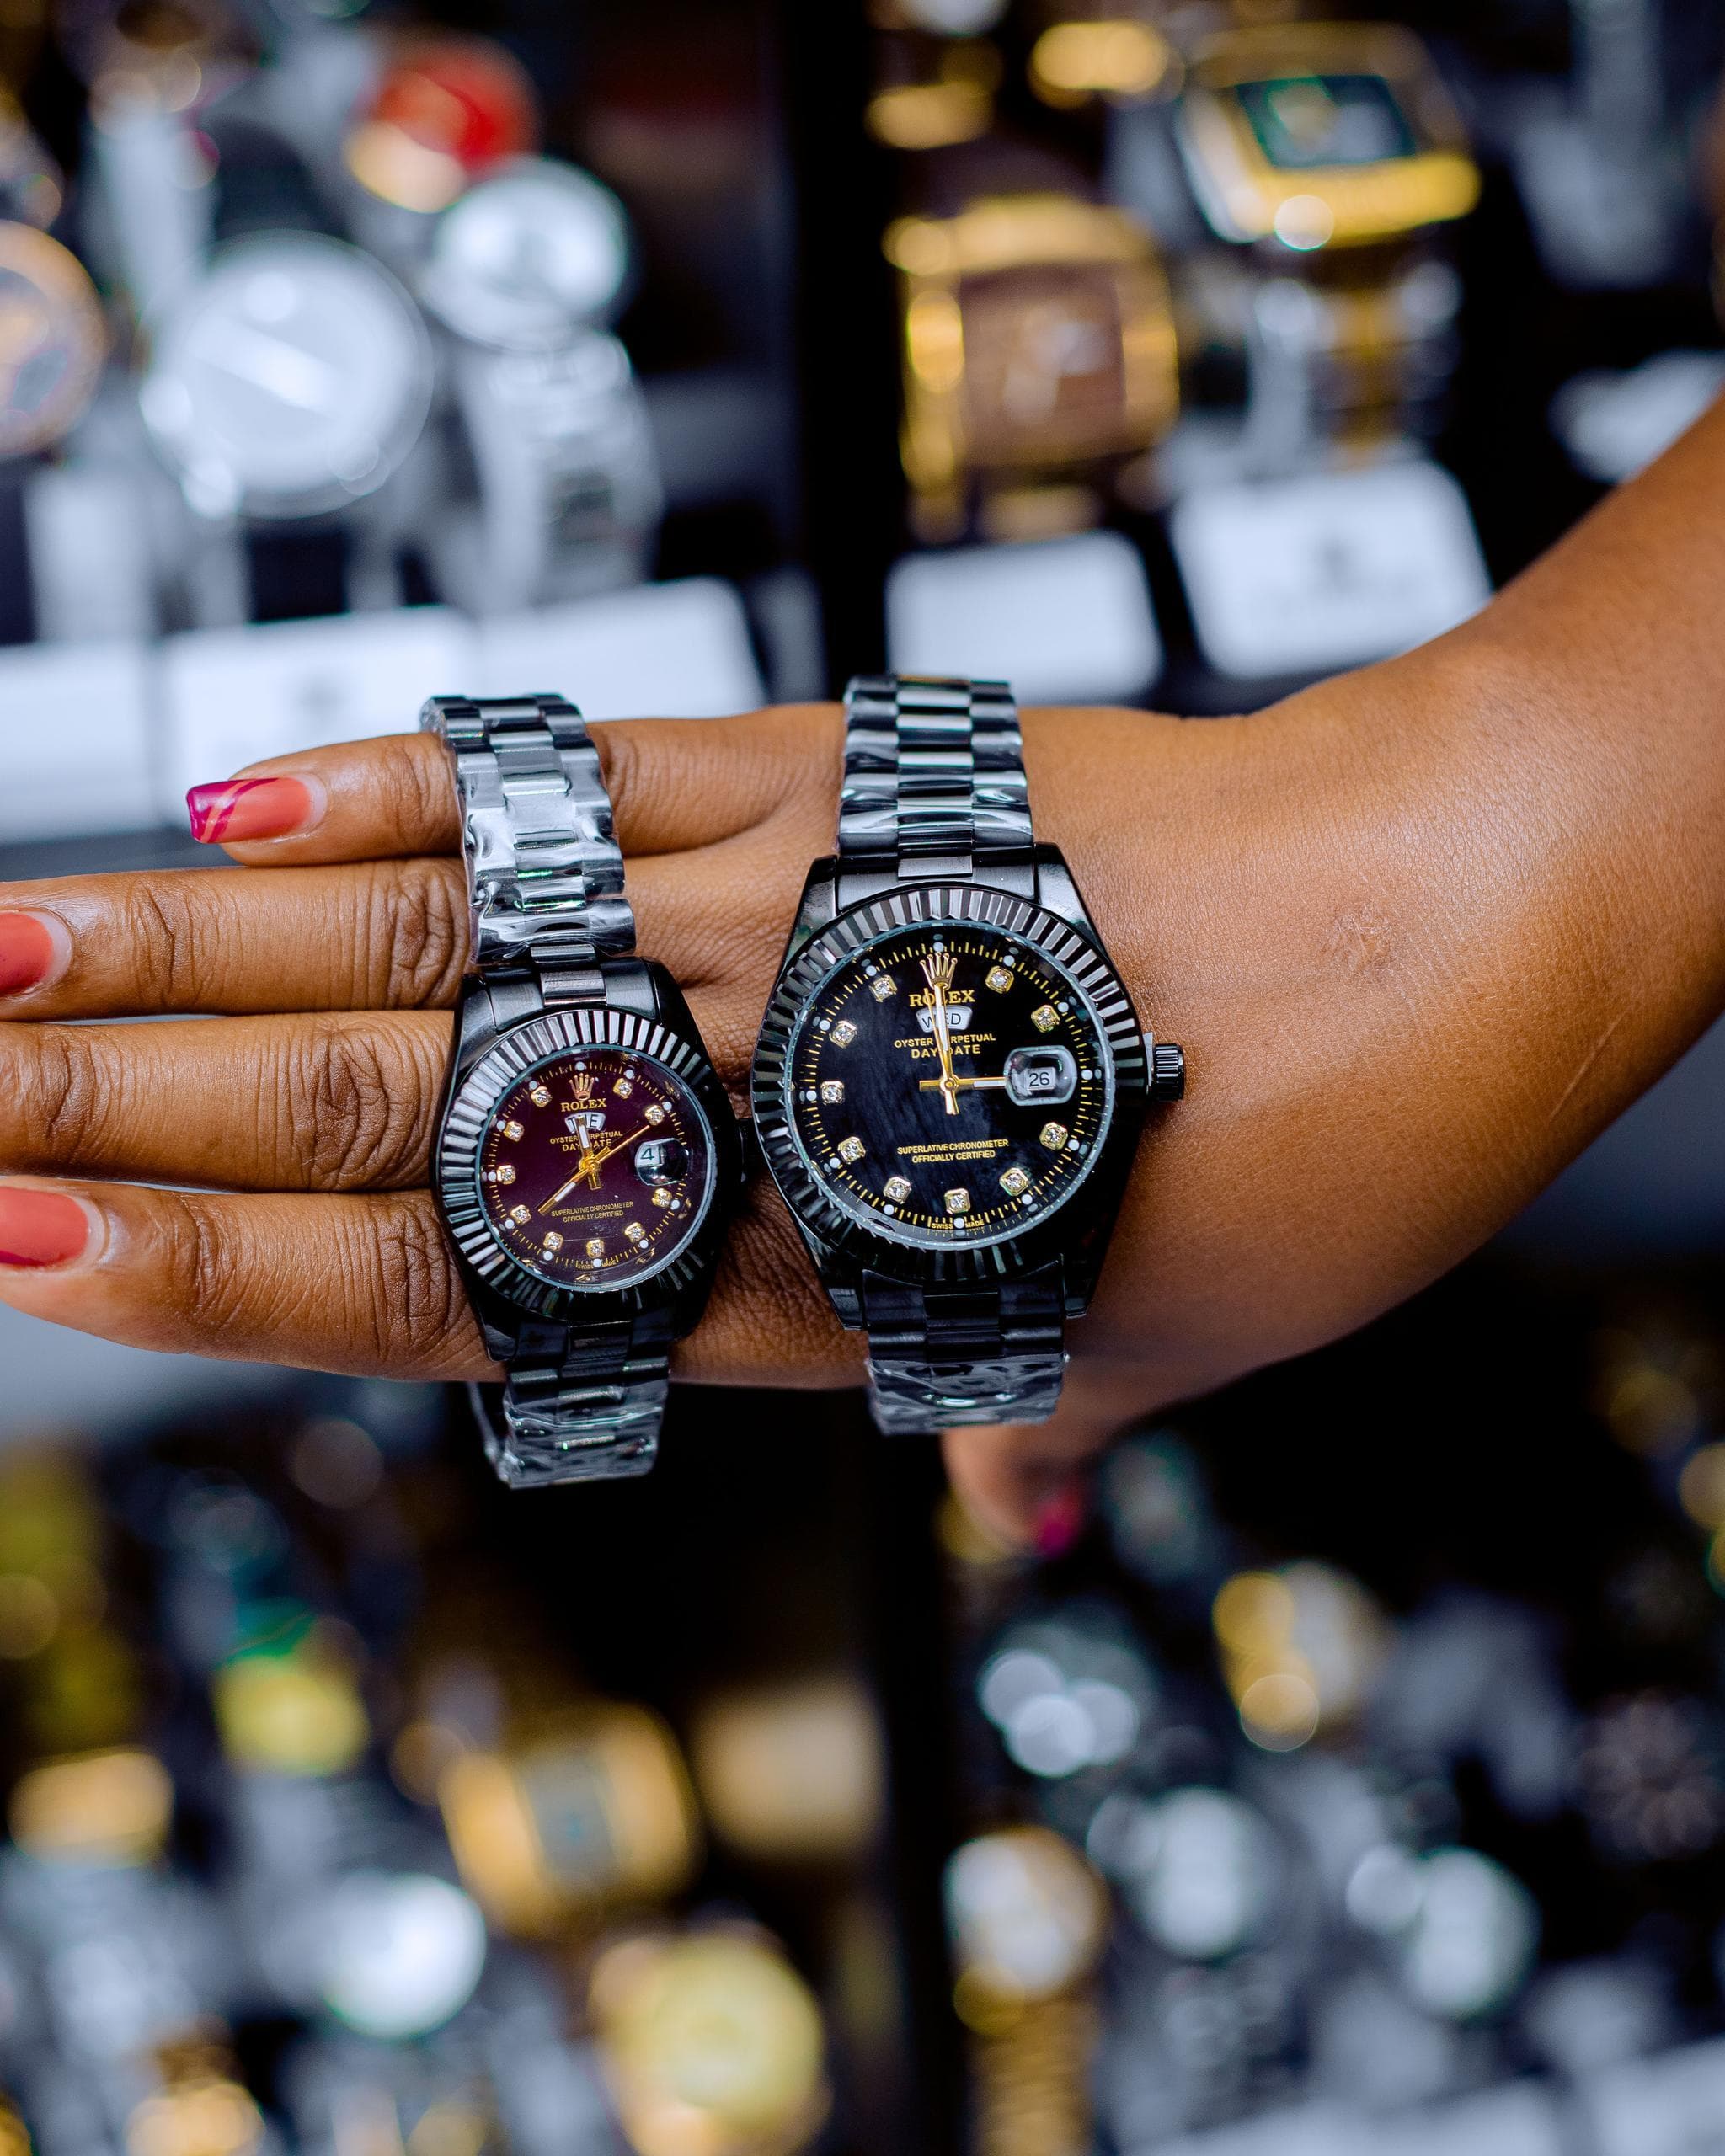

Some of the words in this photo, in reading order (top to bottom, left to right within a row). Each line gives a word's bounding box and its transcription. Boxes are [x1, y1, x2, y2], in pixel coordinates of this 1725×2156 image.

[908, 990, 976, 1007] ROEX
[894, 1038, 934, 1049] OYSTER
[950, 1033, 997, 1044] RPETUAL
[1028, 1071, 1050, 1087] 26
[560, 1097, 607, 1113] ROLEX
[567, 1113, 599, 1129] TE
[549, 1134, 579, 1145] OYSTER
[590, 1130, 623, 1139] RPETUAL
[896, 1144, 949, 1155] SUPERLATIVE
[948, 1139, 1009, 1151] CHRONOMETER
[911, 1152, 955, 1164] OFFICIALLY
[955, 1150, 996, 1161] CERTIFIED
[551, 1206, 590, 1217] SUPERLATIVE
[590, 1201, 634, 1213] CHRONOMETER
[563, 1213, 595, 1223] OFFICIALLY
[594, 1209, 624, 1219] CERTIFIED
[964, 1219, 985, 1228] MADE
